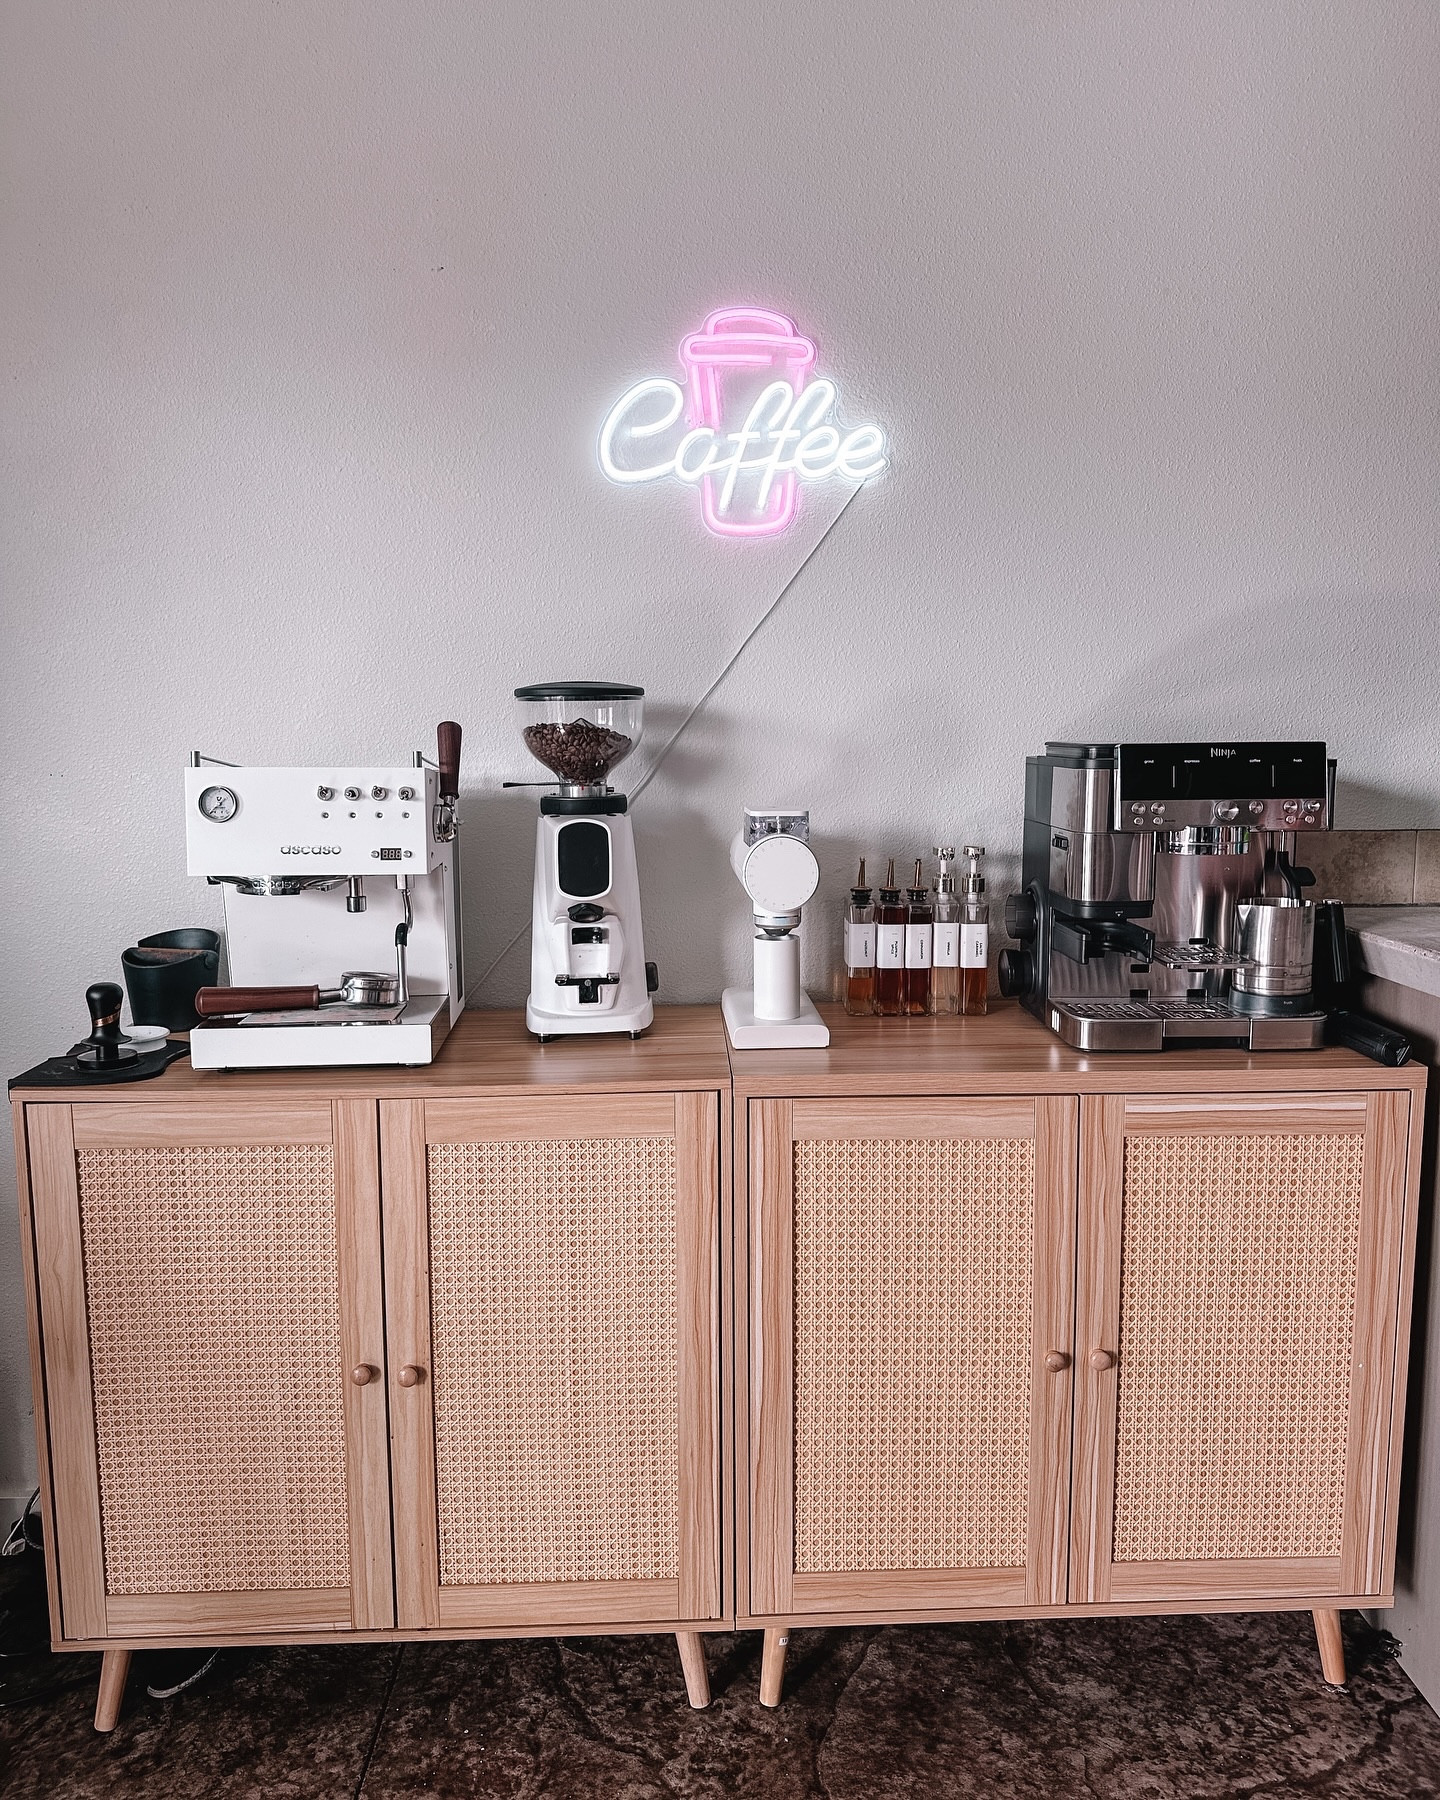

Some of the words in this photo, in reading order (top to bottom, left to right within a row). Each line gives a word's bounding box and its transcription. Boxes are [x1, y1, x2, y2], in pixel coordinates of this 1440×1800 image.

[600, 378, 886, 513] Coffee
[1210, 747, 1237, 759] NINJA
[280, 845, 342, 855] ascaso
